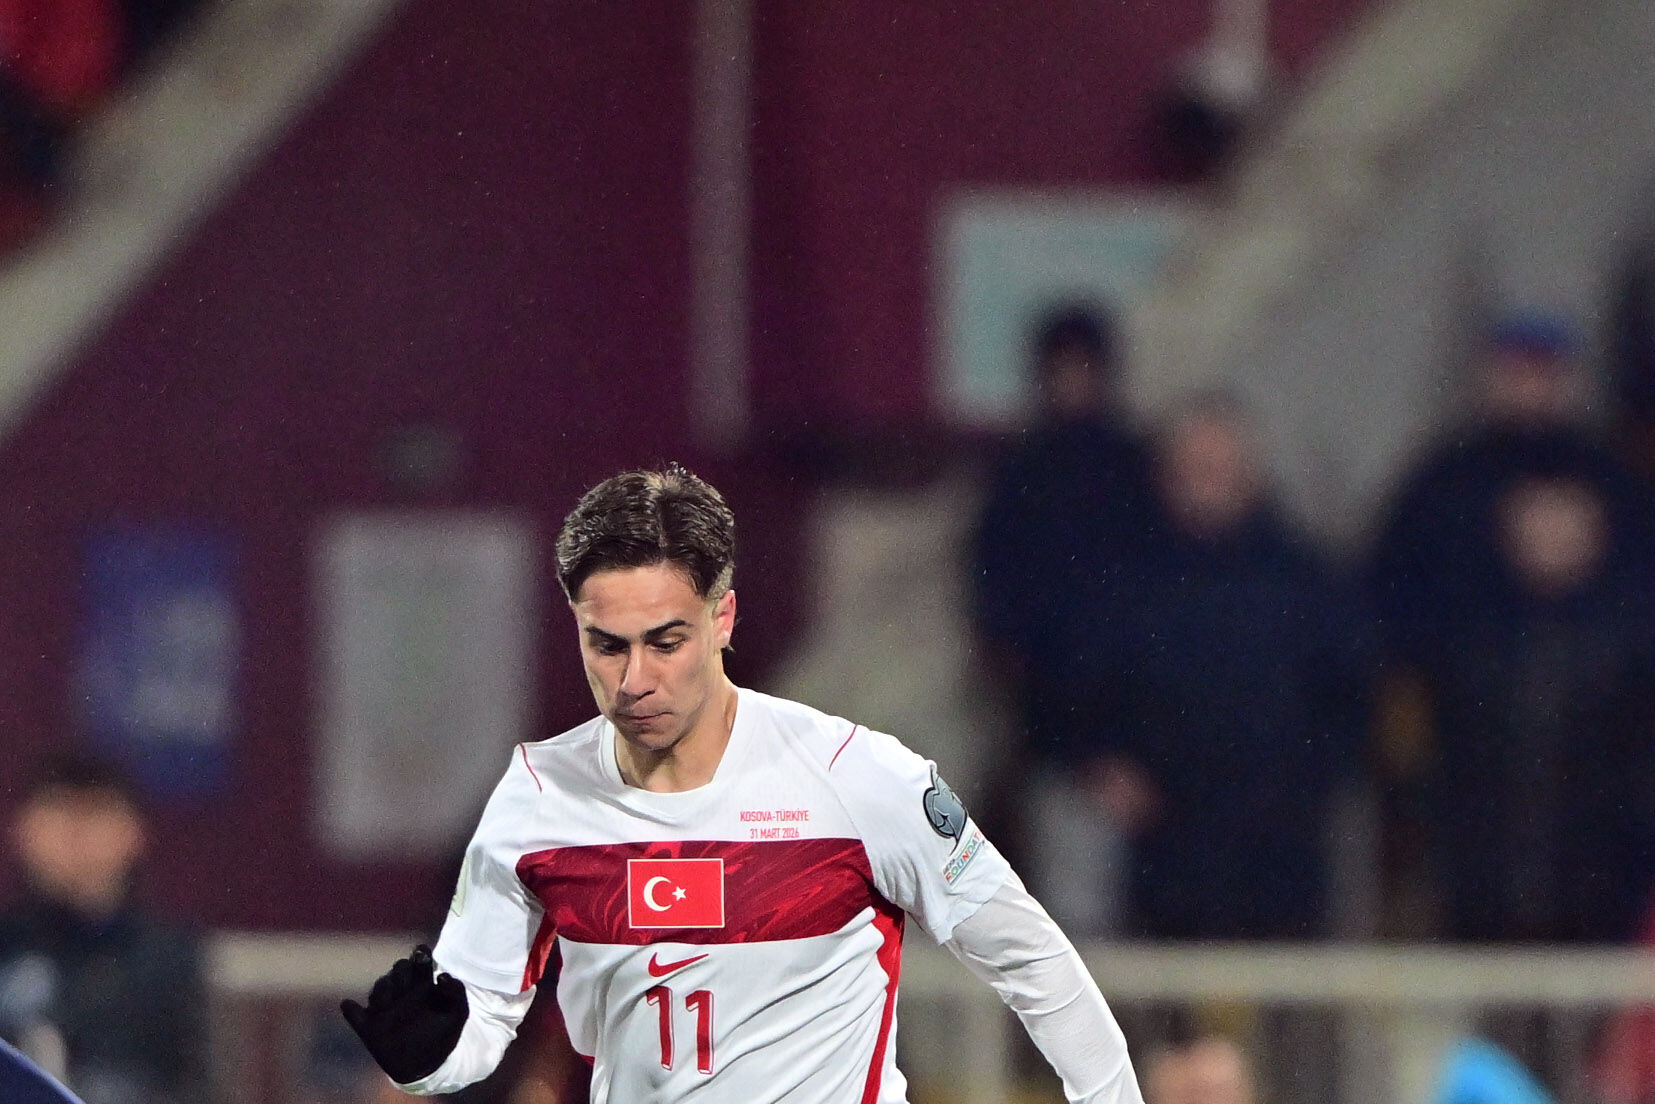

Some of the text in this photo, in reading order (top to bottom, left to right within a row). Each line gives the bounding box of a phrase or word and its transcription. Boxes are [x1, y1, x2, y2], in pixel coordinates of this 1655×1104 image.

[750, 826, 800, 839] 31 MART 2026
[646, 985, 715, 1075] 11
